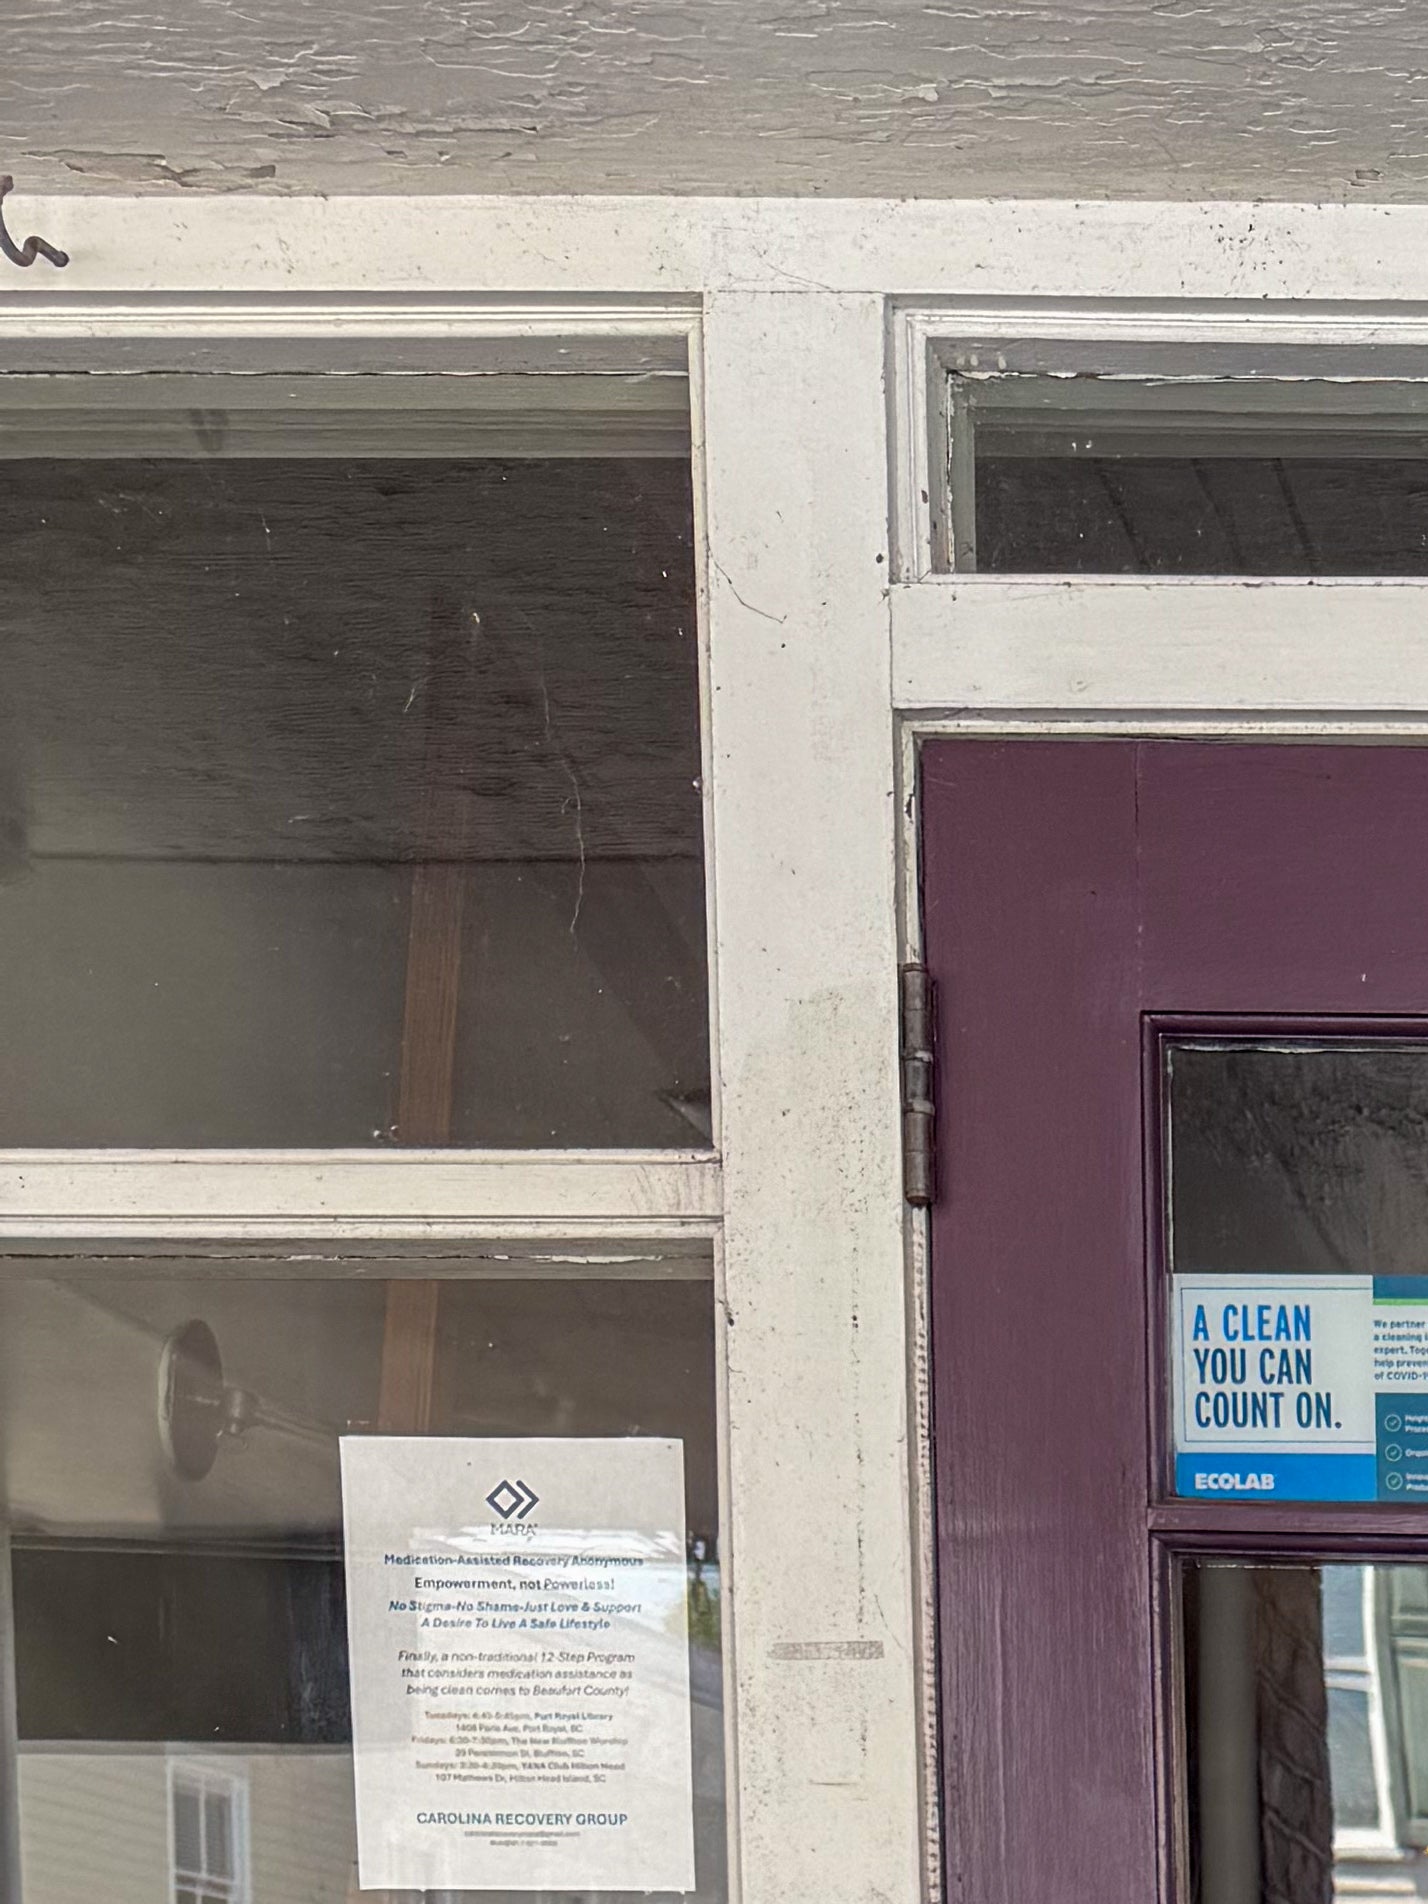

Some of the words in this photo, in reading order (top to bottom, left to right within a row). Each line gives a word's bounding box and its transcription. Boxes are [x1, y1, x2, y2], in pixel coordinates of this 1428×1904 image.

[1192, 1304, 1209, 1341] A
[1222, 1304, 1311, 1341] CLEAN
[1374, 1320, 1387, 1328] We
[1390, 1321, 1425, 1329] partner
[1382, 1334, 1422, 1342] cleaning
[1193, 1348, 1247, 1385] YOU
[1259, 1349, 1312, 1385] CAN
[1374, 1358, 1394, 1368] help
[1374, 1372, 1384, 1380] of
[1195, 1392, 1285, 1429] COUNT
[1296, 1392, 1342, 1429] ON.
[1195, 1473, 1275, 1490] ECOLAB
[384, 1555, 510, 1567] Medication-Assisted
[415, 1577, 515, 1591] Empowerment,
[520, 1580, 541, 1590] not
[389, 1601, 407, 1611] No
[550, 1602, 578, 1612] Love
[581, 1602, 590, 1612] &
[593, 1602, 641, 1614] Support
[421, 1619, 430, 1628] A
[433, 1619, 472, 1628] Desire
[476, 1619, 489, 1628] To
[492, 1619, 516, 1629] Live
[519, 1619, 527, 1629] A
[530, 1619, 557, 1629] Safe
[560, 1619, 610, 1630] Lifestyle
[587, 1652, 635, 1663] Program
[401, 1669, 425, 1678] that
[487, 1669, 552, 1679] medication
[555, 1670, 616, 1679] assistance
[407, 1685, 438, 1697] being
[441, 1686, 473, 1695] clean
[476, 1687, 515, 1696] comes
[519, 1686, 530, 1696] to
[417, 1813, 492, 1824] CAROLINA
[496, 1814, 572, 1825] RECOVERY
[576, 1814, 628, 1825] GROUP
